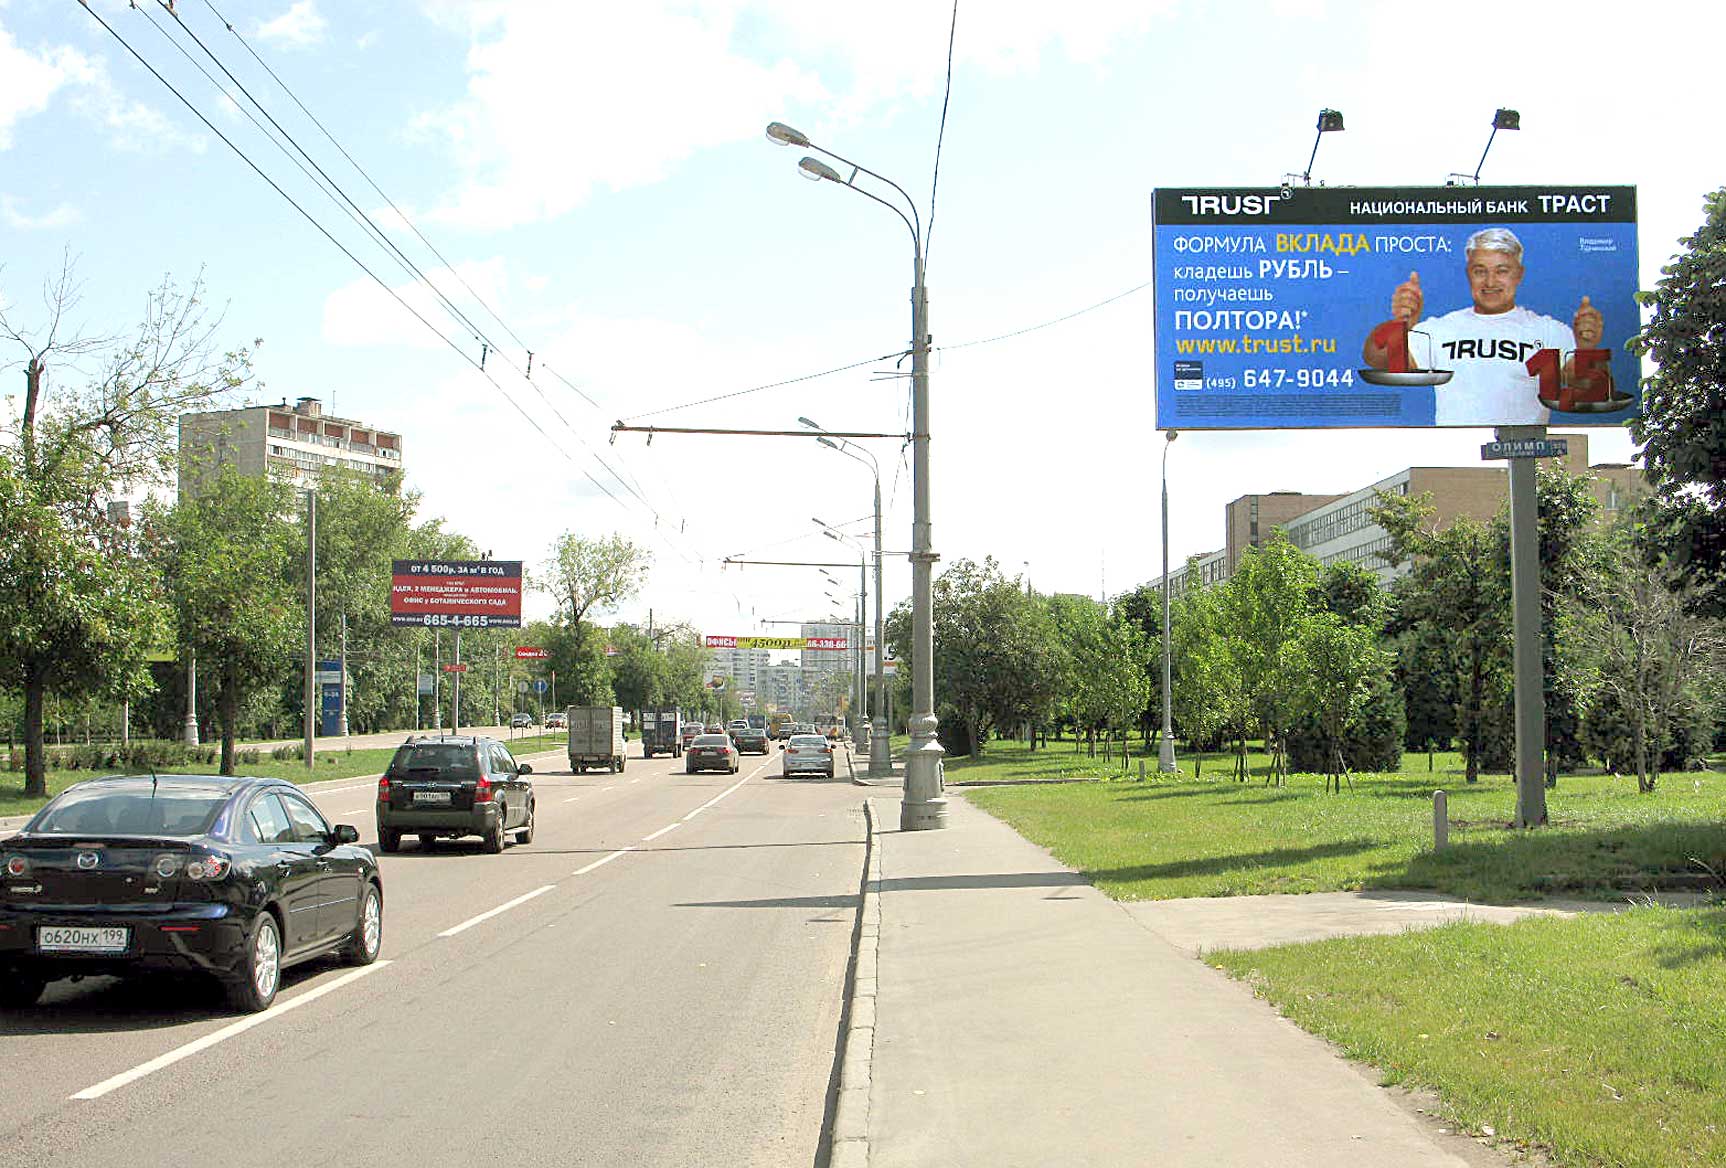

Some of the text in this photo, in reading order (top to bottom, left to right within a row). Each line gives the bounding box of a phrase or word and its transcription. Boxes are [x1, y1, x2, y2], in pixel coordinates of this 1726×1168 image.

[1181, 195, 1281, 215] TRUST
[1350, 195, 1611, 216] НАЦИОНАЛЬНЫЙ БАНК ТРАСТ
[1173, 233, 1453, 256] ФОРМУЛА ВКЛАДА ПРОСТА:
[1174, 265, 1253, 282] кладешь
[1259, 259, 1333, 279] РУБЛЬ
[1174, 288, 1273, 306] получаешь
[1176, 333, 1338, 355] www.trust.ru
[1441, 339, 1535, 362] TRUST
[1205, 376, 1237, 390] (495)
[1243, 368, 1355, 388] 647-9044
[1492, 441, 1546, 452] ОЛИМП
[422, 563, 429, 573] 4
[457, 566, 468, 574] ЗА
[488, 566, 505, 576] ГОД
[488, 598, 507, 606] САДА
[423, 614, 488, 627] 665-4-665
[102, 929, 124, 941] 199
